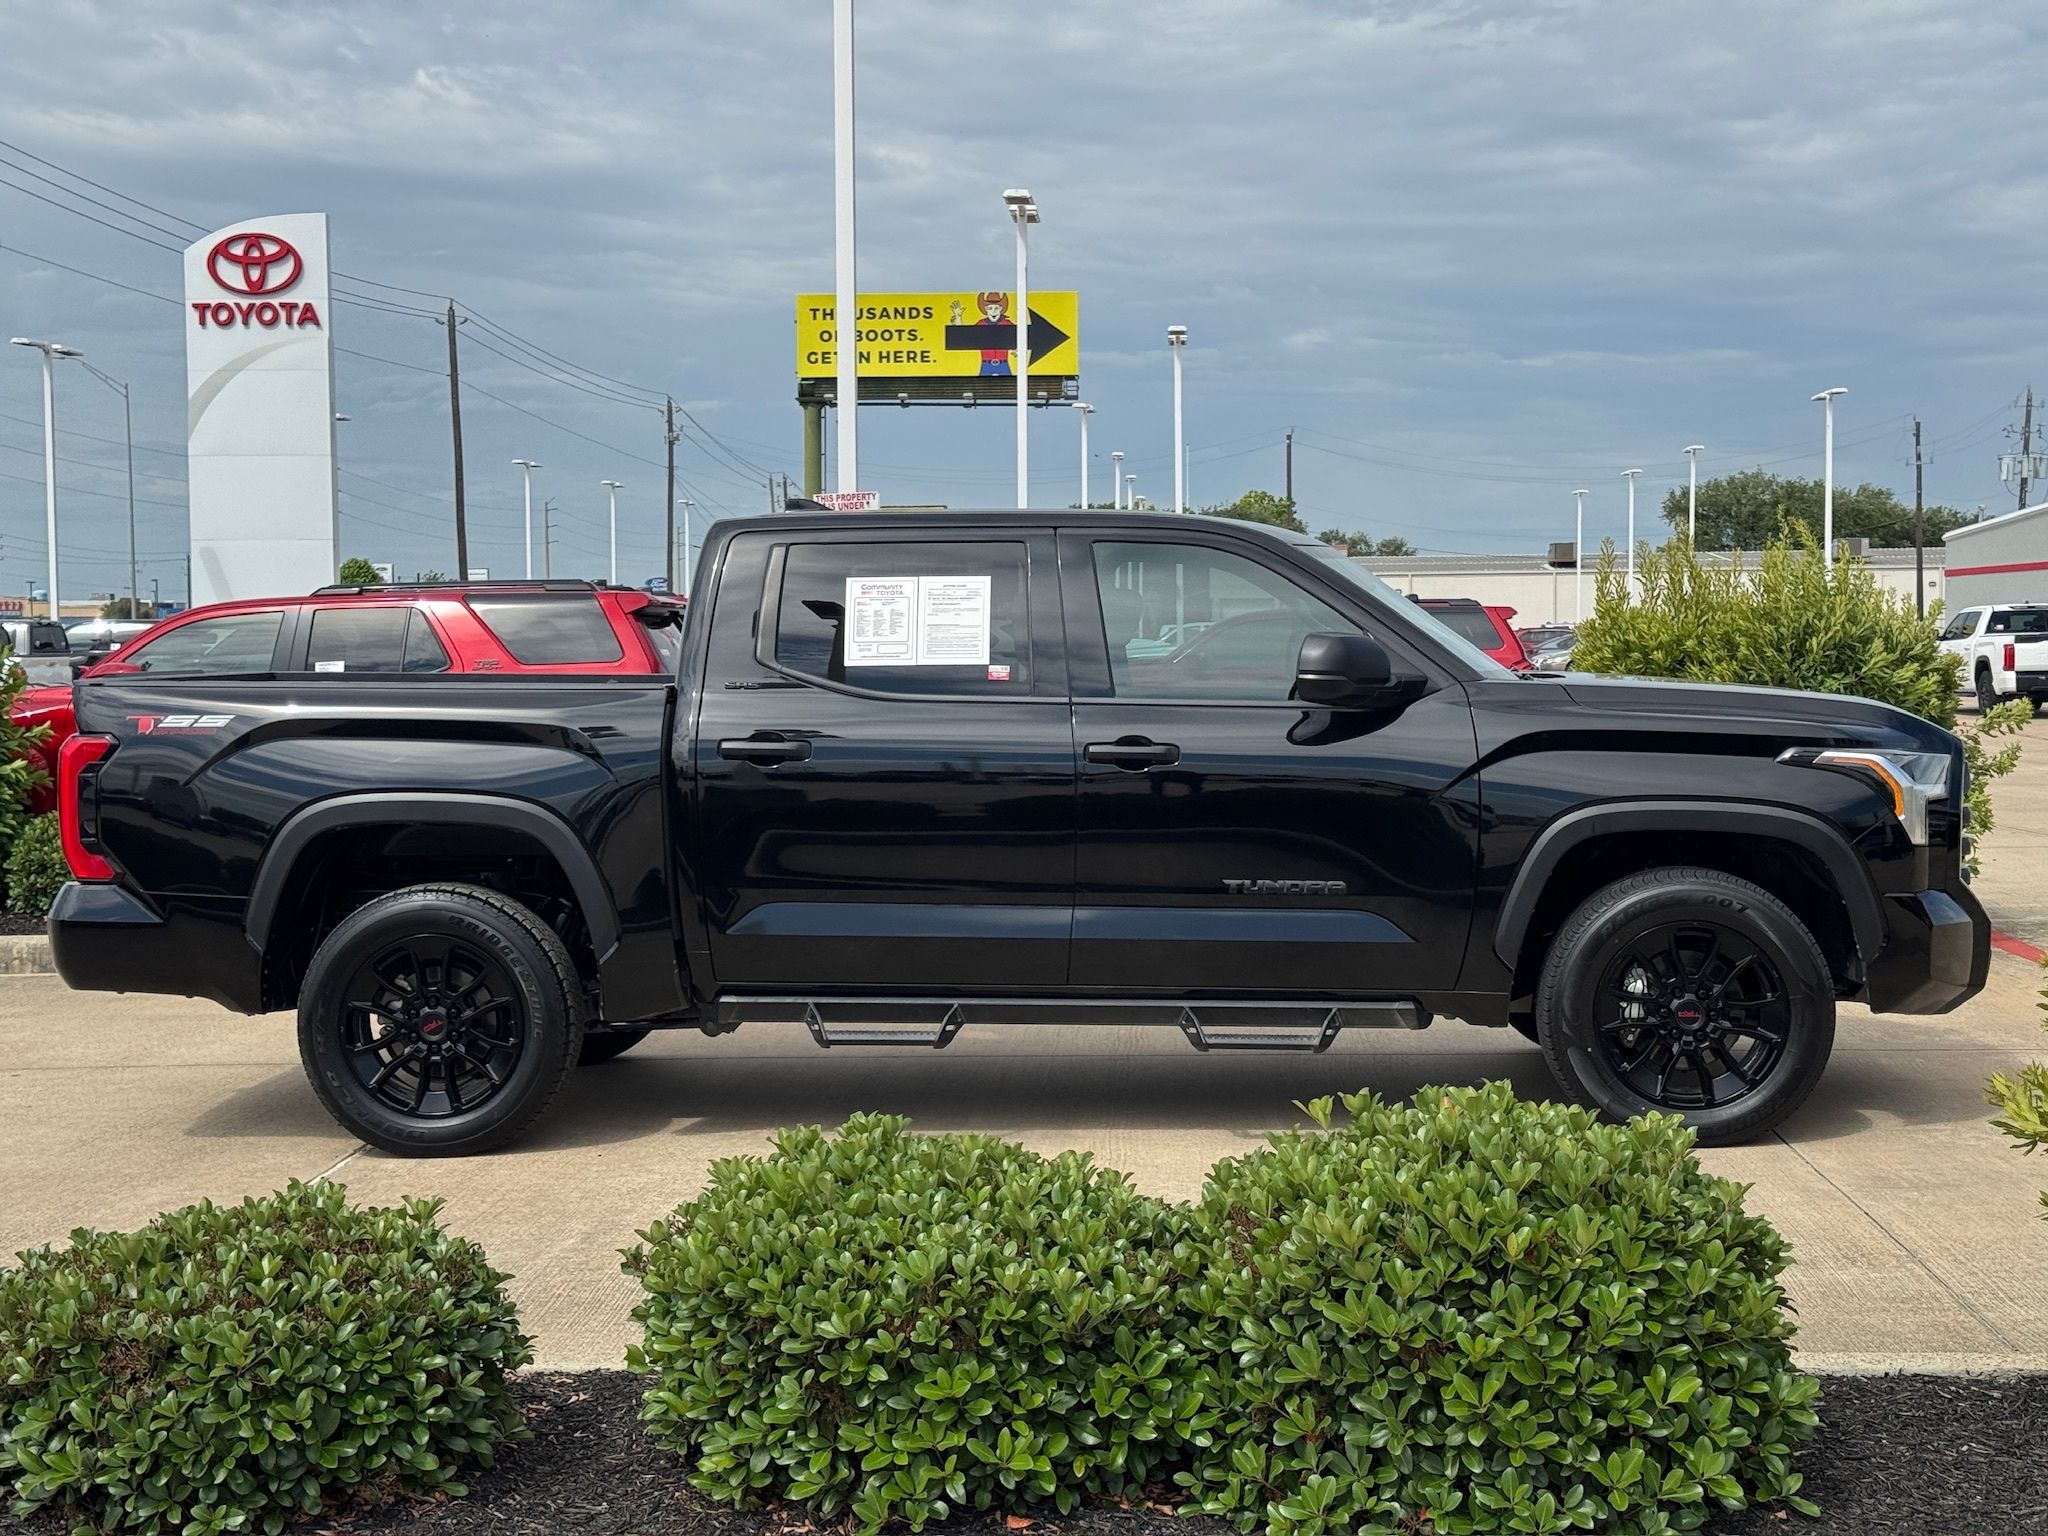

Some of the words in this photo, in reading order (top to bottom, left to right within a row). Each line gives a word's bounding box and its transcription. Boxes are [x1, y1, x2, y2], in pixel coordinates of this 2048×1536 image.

[192, 302, 320, 326] TOYOTA
[809, 306, 933, 321] THUSANDS
[819, 330, 838, 342] O
[878, 350, 937, 363] HERE.
[815, 494, 834, 503] THIS
[836, 492, 876, 502] PROPERTY
[838, 502, 864, 510] UNDER
[1222, 879, 1348, 894] TUNDRA
